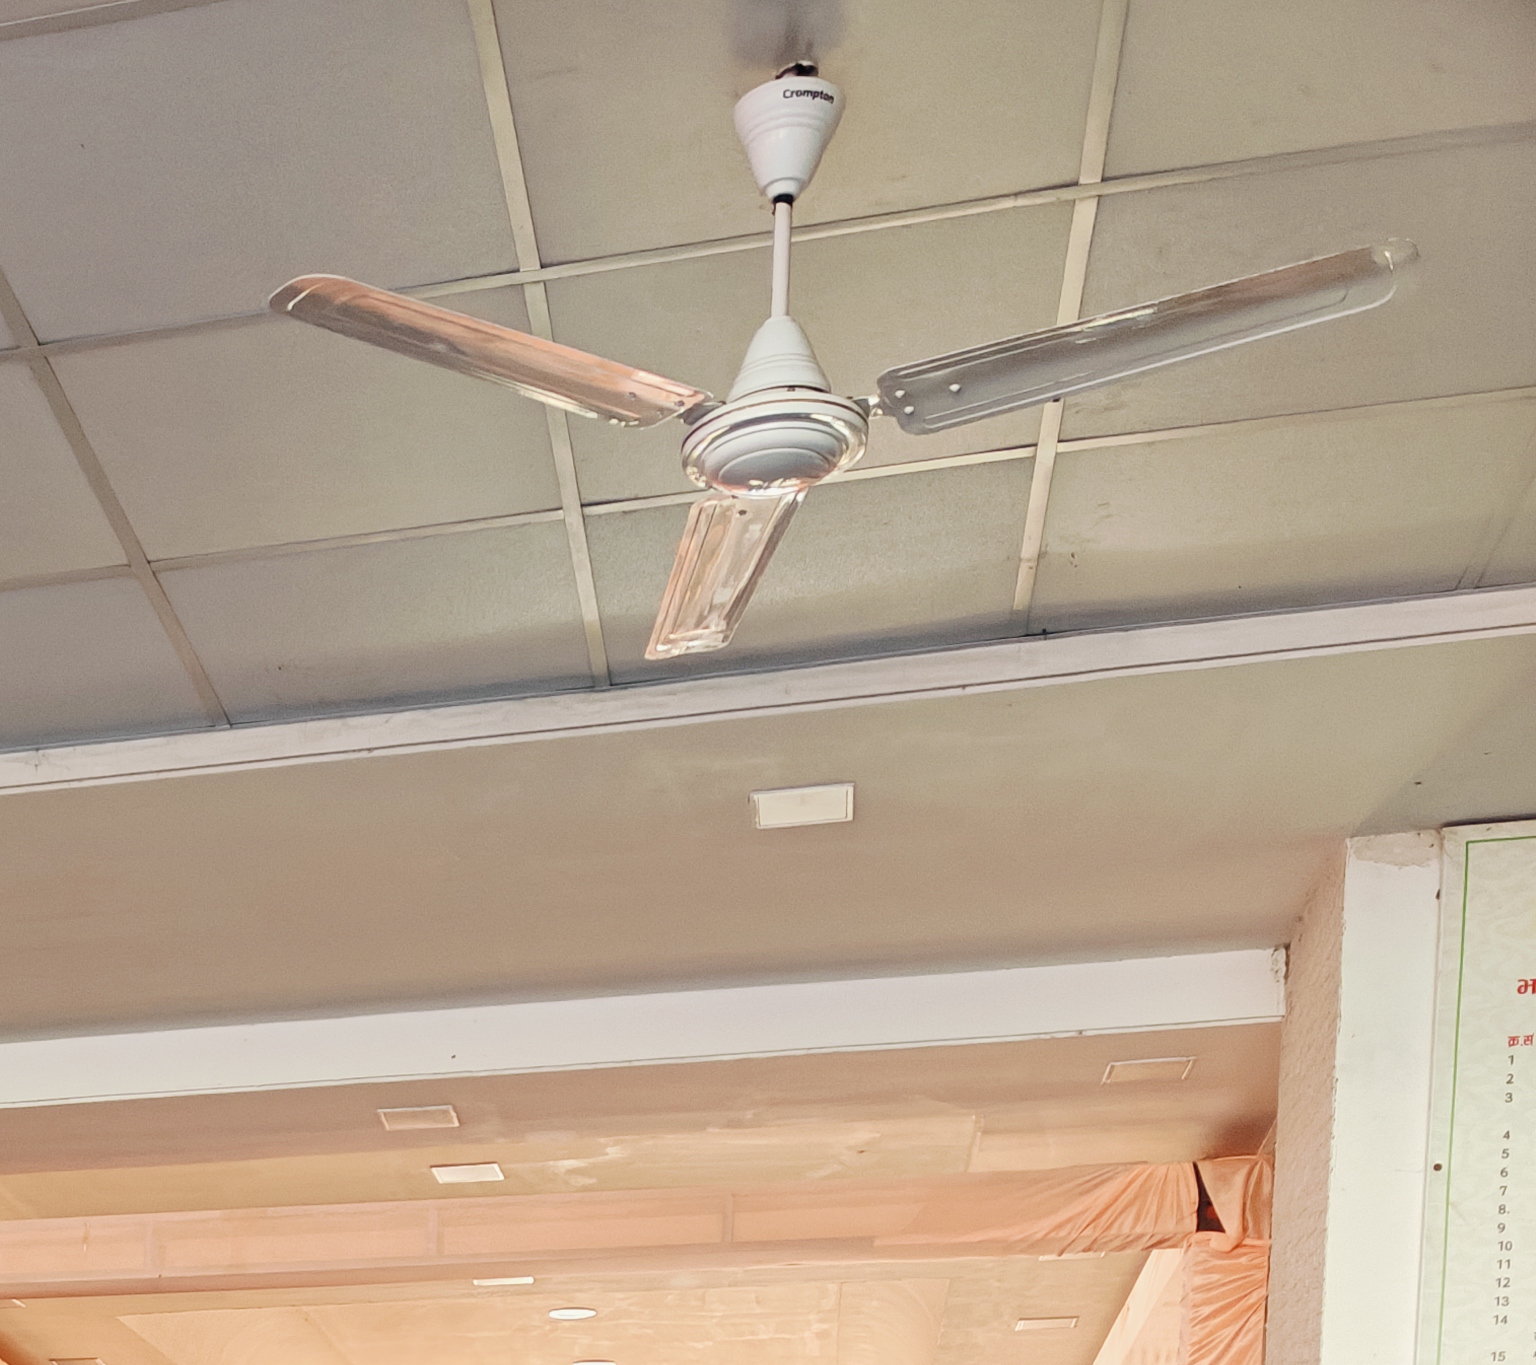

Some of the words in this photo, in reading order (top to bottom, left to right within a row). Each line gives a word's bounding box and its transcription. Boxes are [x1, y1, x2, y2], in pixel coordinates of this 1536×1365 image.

[783, 88, 834, 104] Crompton
[1508, 1055, 1514, 1065] 1
[1506, 1073, 1514, 1084] 2
[1505, 1093, 1513, 1103] 3
[1502, 1130, 1510, 1140] 4
[1501, 1148, 1510, 1159] 5
[1500, 1167, 1508, 1178] 6
[1499, 1185, 1508, 1196] 7
[1498, 1203, 1510, 1215] 8.
[1497, 1222, 1506, 1233] 9
[1497, 1240, 1513, 1251] 10
[1496, 1259, 1511, 1270] 11
[1495, 1277, 1511, 1288] 12
[1494, 1296, 1510, 1306] 13
[1493, 1314, 1508, 1325] 14
[1491, 1351, 1506, 1362] 15
